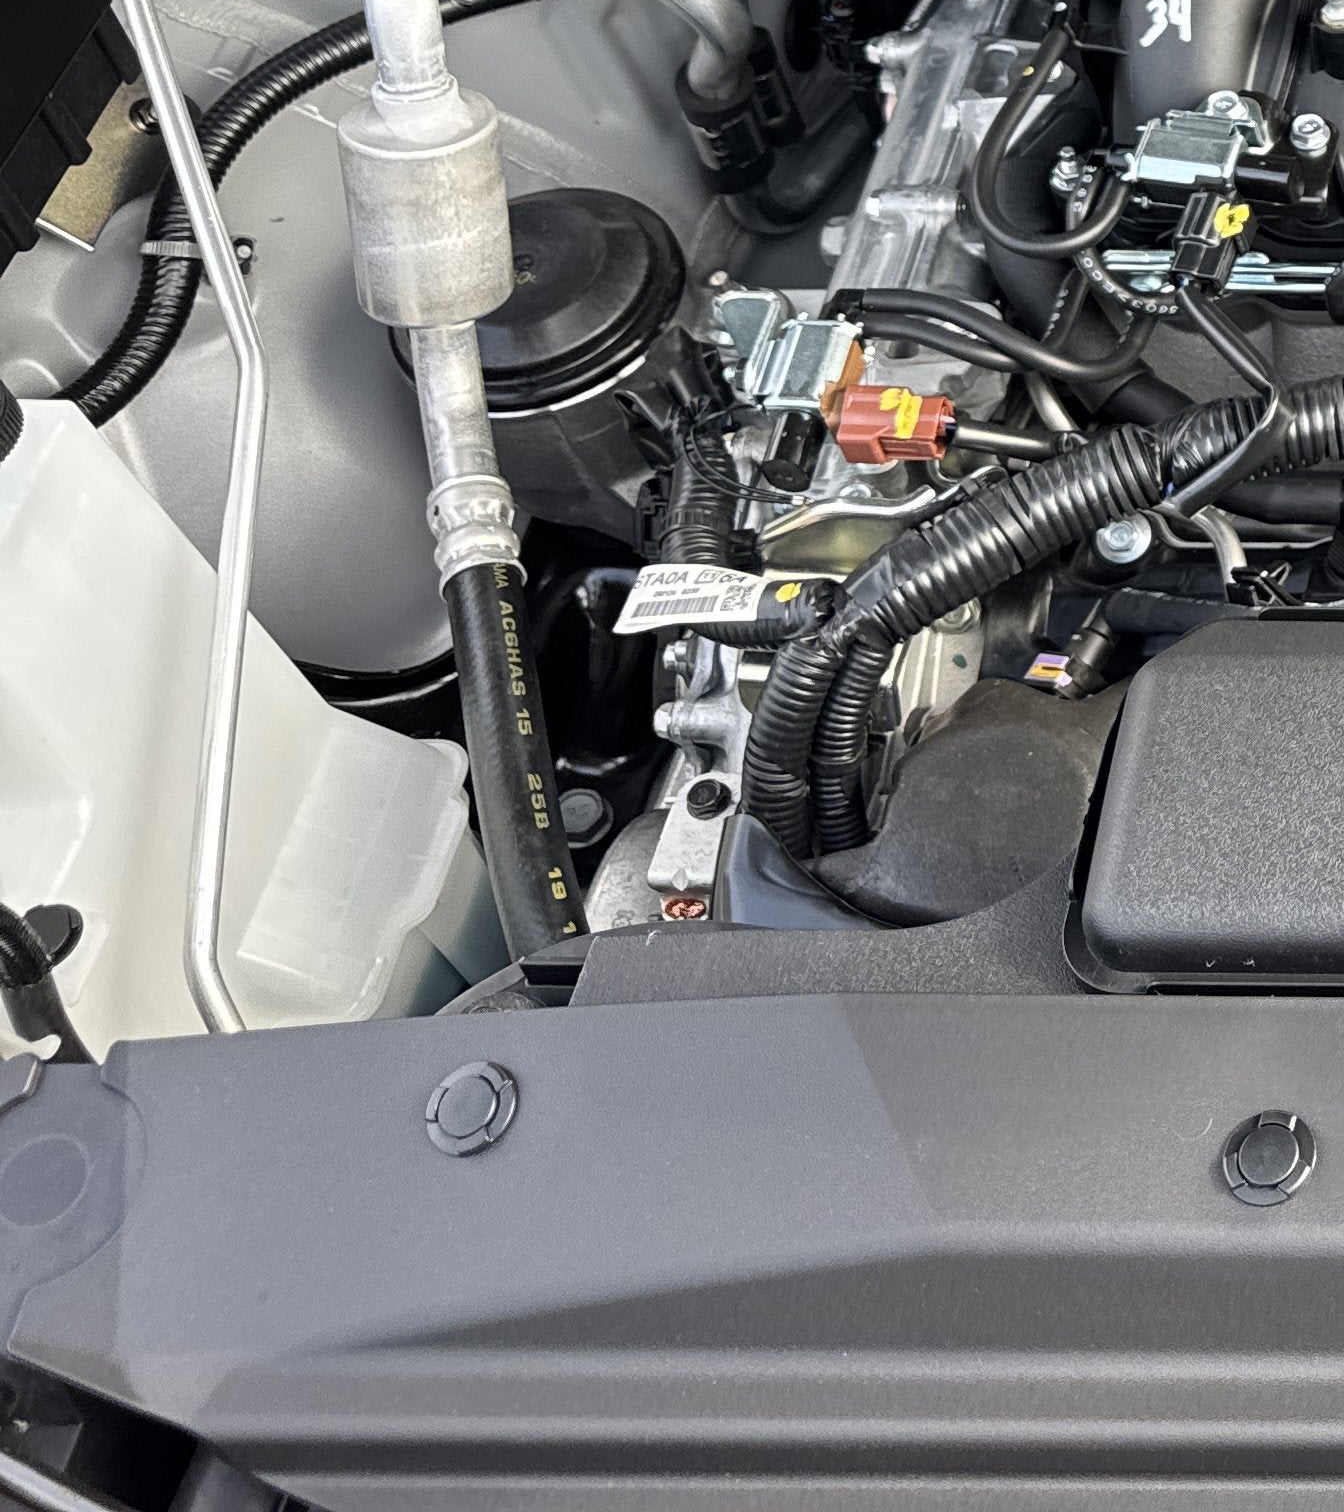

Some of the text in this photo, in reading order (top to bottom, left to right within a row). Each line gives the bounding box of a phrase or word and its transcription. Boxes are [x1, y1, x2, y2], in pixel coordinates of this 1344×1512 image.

[516, 707, 534, 736] 15
[527, 772, 551, 830] 25B
[547, 866, 568, 900] 19
